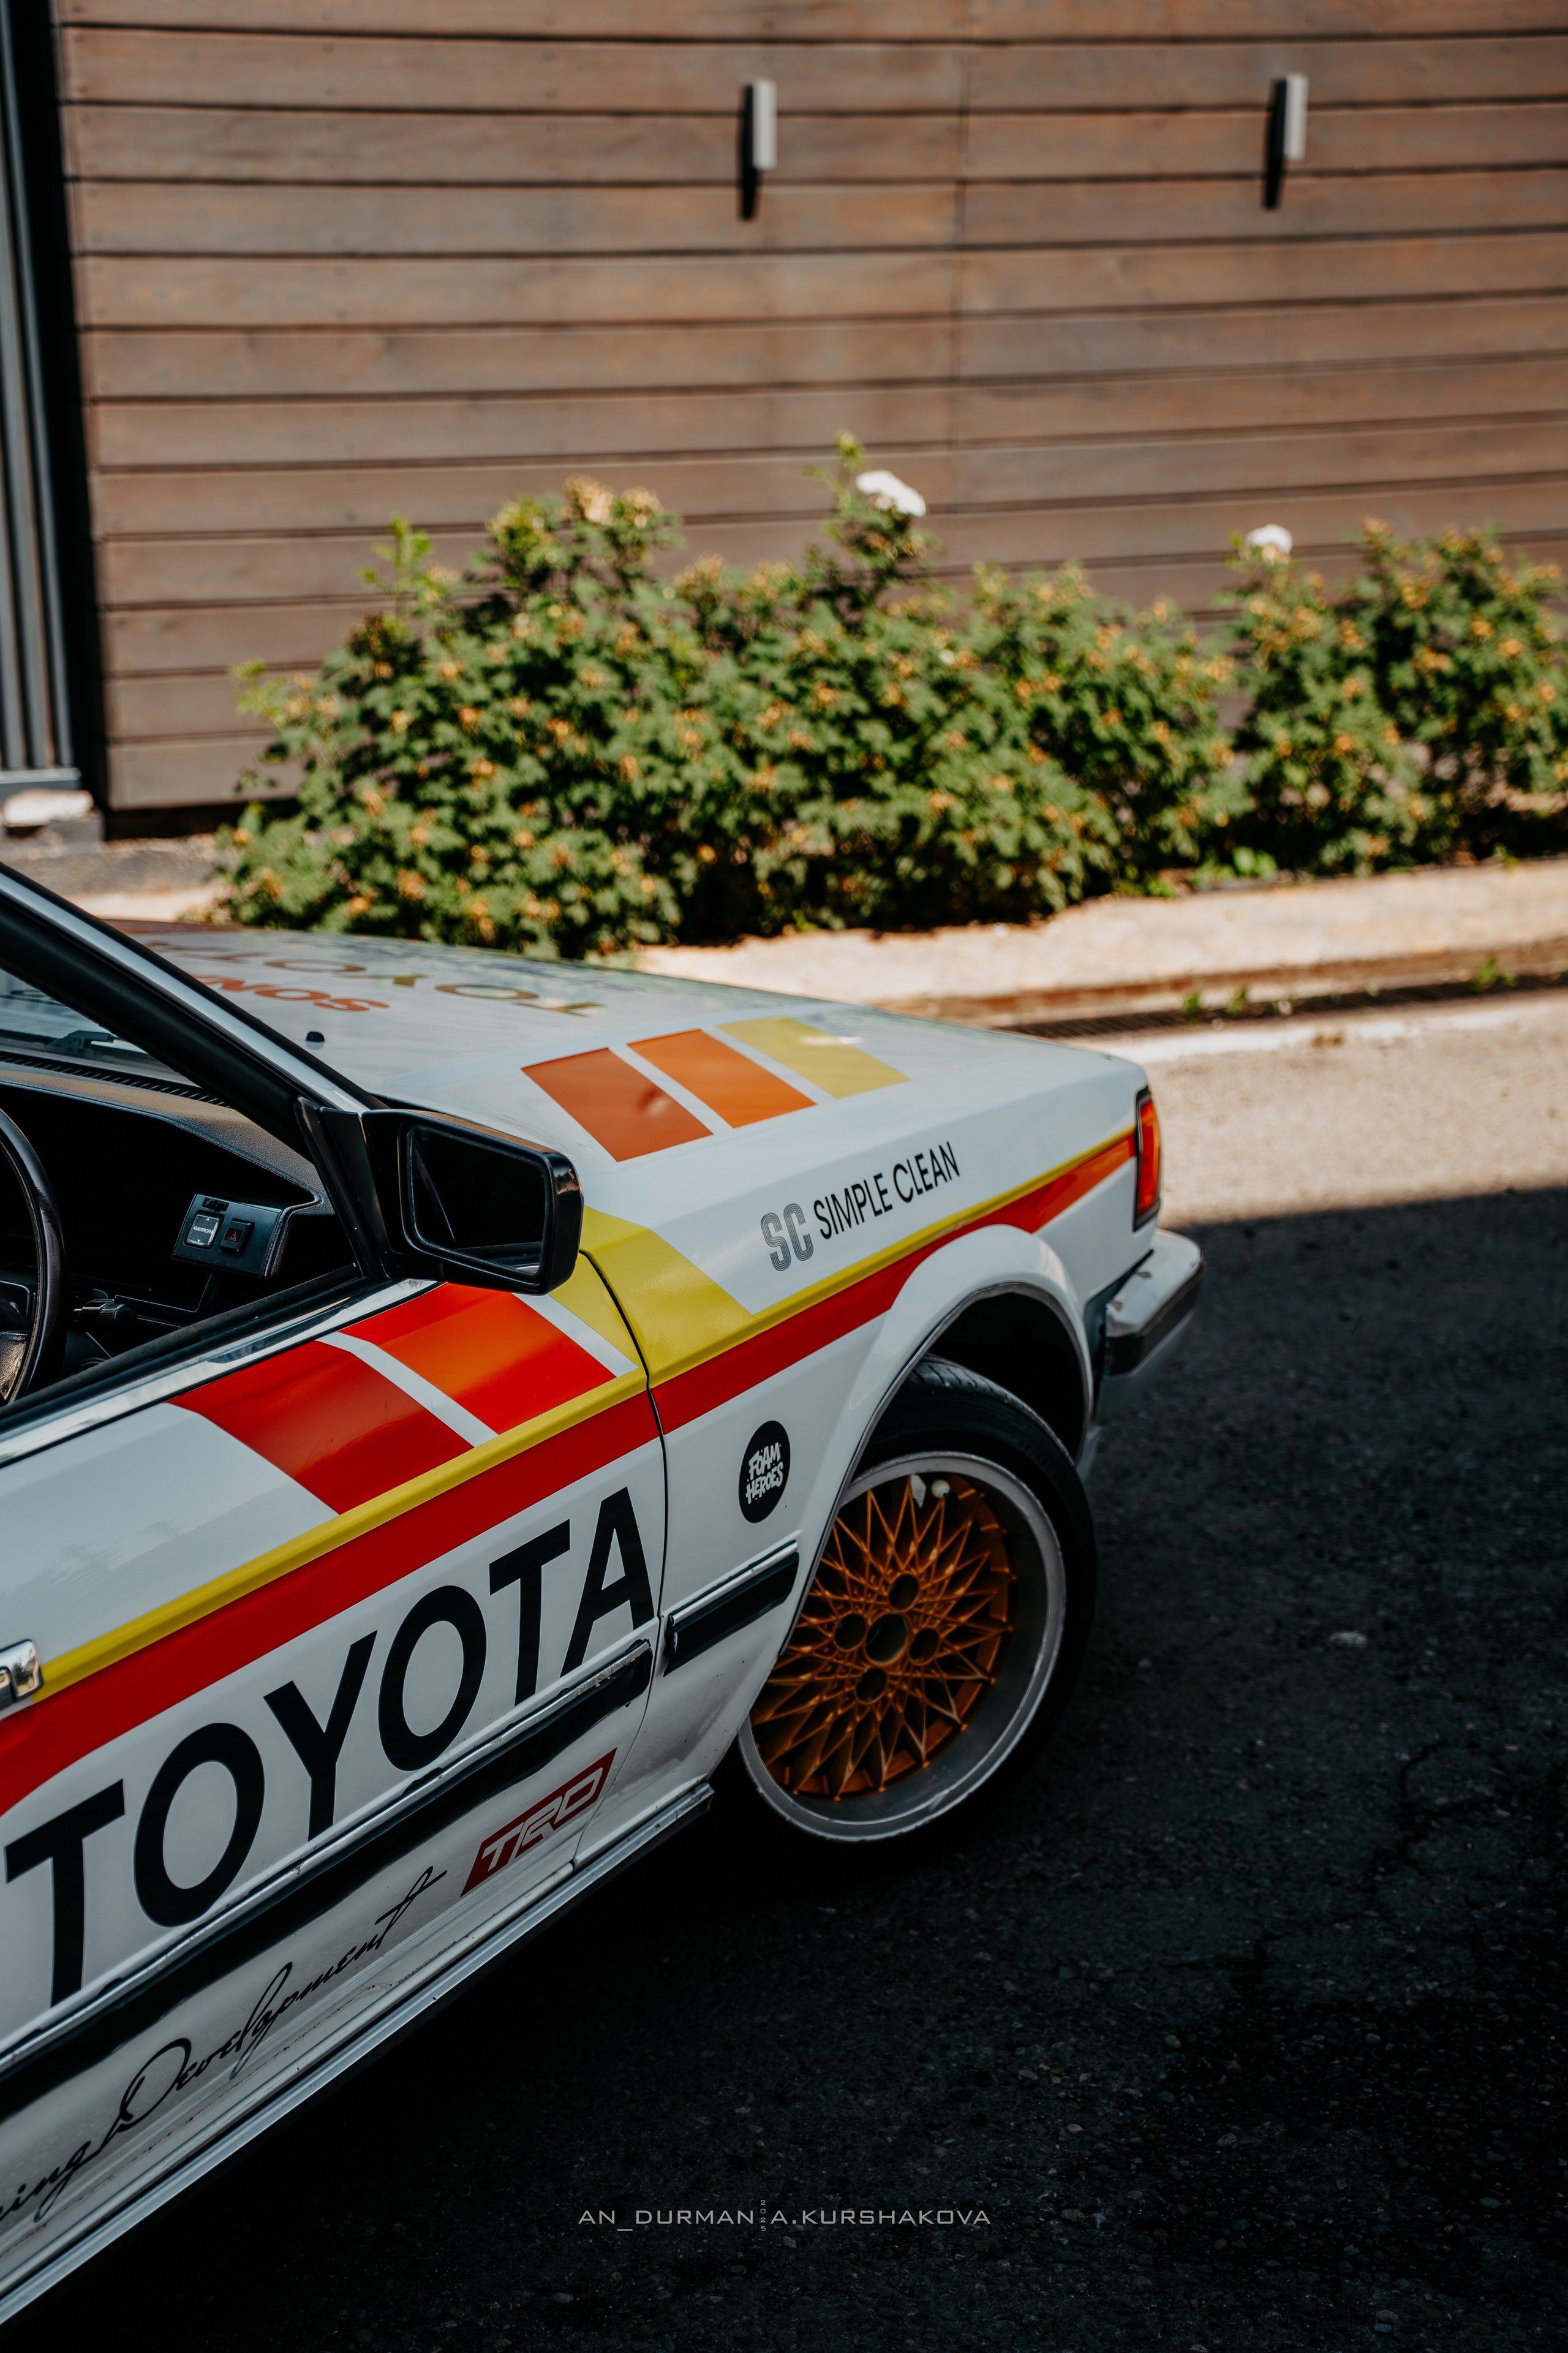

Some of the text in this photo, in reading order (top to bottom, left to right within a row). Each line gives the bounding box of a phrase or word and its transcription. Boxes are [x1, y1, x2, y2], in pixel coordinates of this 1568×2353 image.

[186, 973, 390, 1011] SON
[760, 1141, 960, 1271] SC SIMPLE CLEAN
[745, 1462, 783, 1505] HEROES
[748, 1442, 781, 1480] FOAM
[5, 1487, 656, 2007] TOYOTA
[481, 1767, 603, 1872] TRD
[100, 1866, 447, 2080] Development
